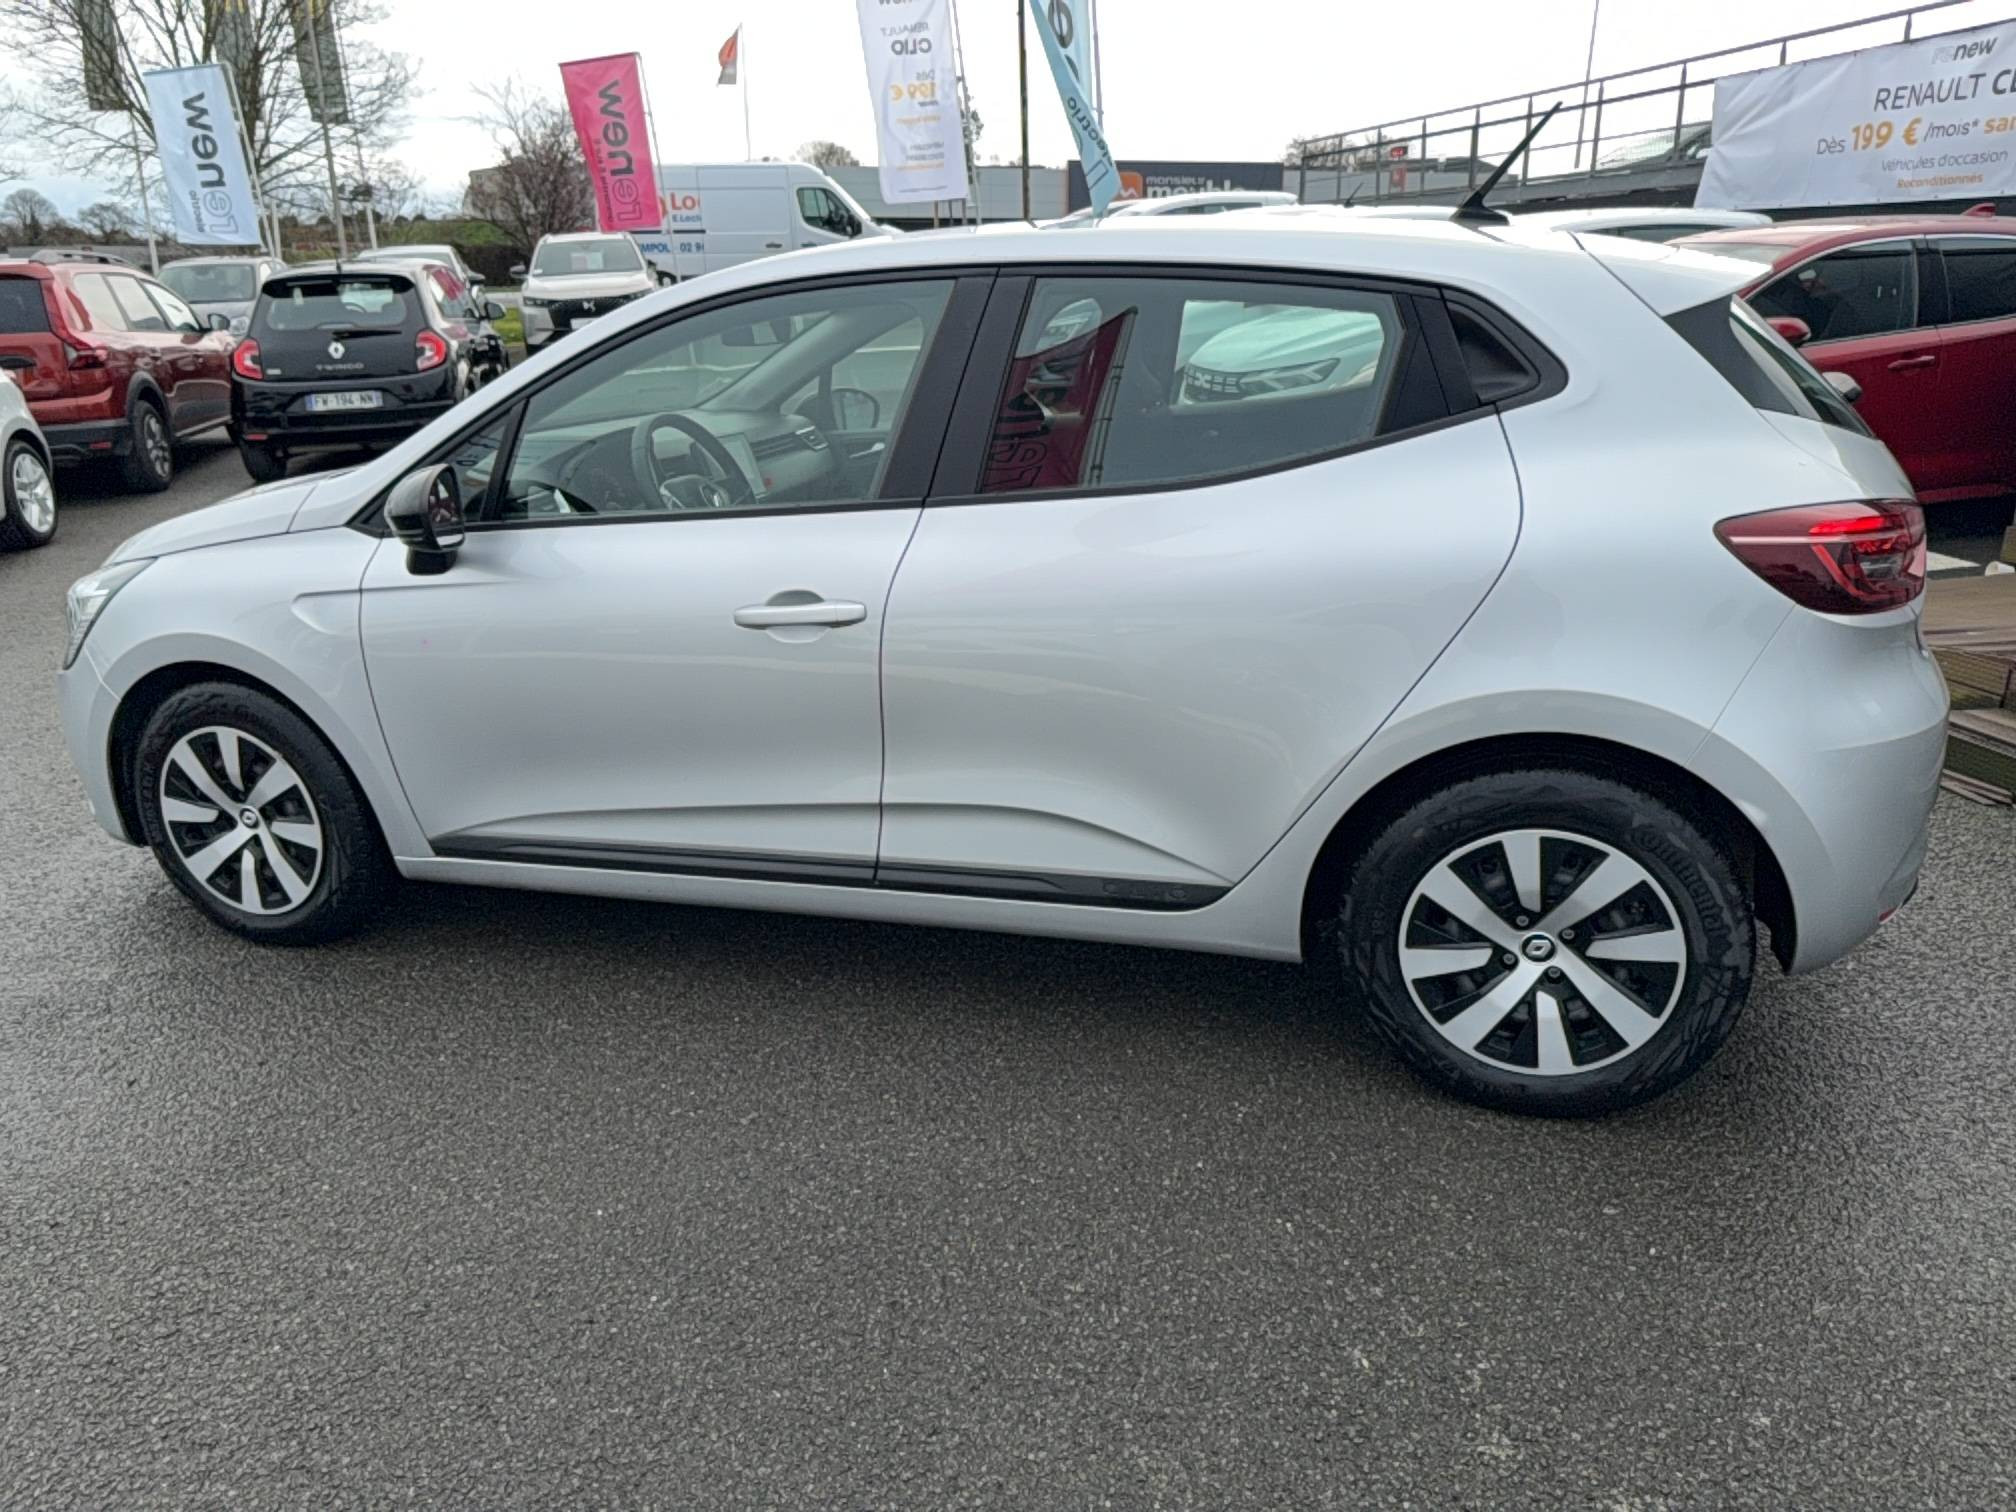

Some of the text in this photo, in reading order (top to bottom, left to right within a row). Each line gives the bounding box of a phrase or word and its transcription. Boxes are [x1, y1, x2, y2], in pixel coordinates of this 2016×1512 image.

[1873, 72, 1987, 112] RENAULT
[1816, 136, 1846, 155] Dès
[1851, 120, 1894, 151] 199
[1902, 117, 1922, 146] €
[1938, 150, 2008, 167] d'occasion
[1146, 175, 1205, 185] monsieur
[670, 192, 700, 211] Lo
